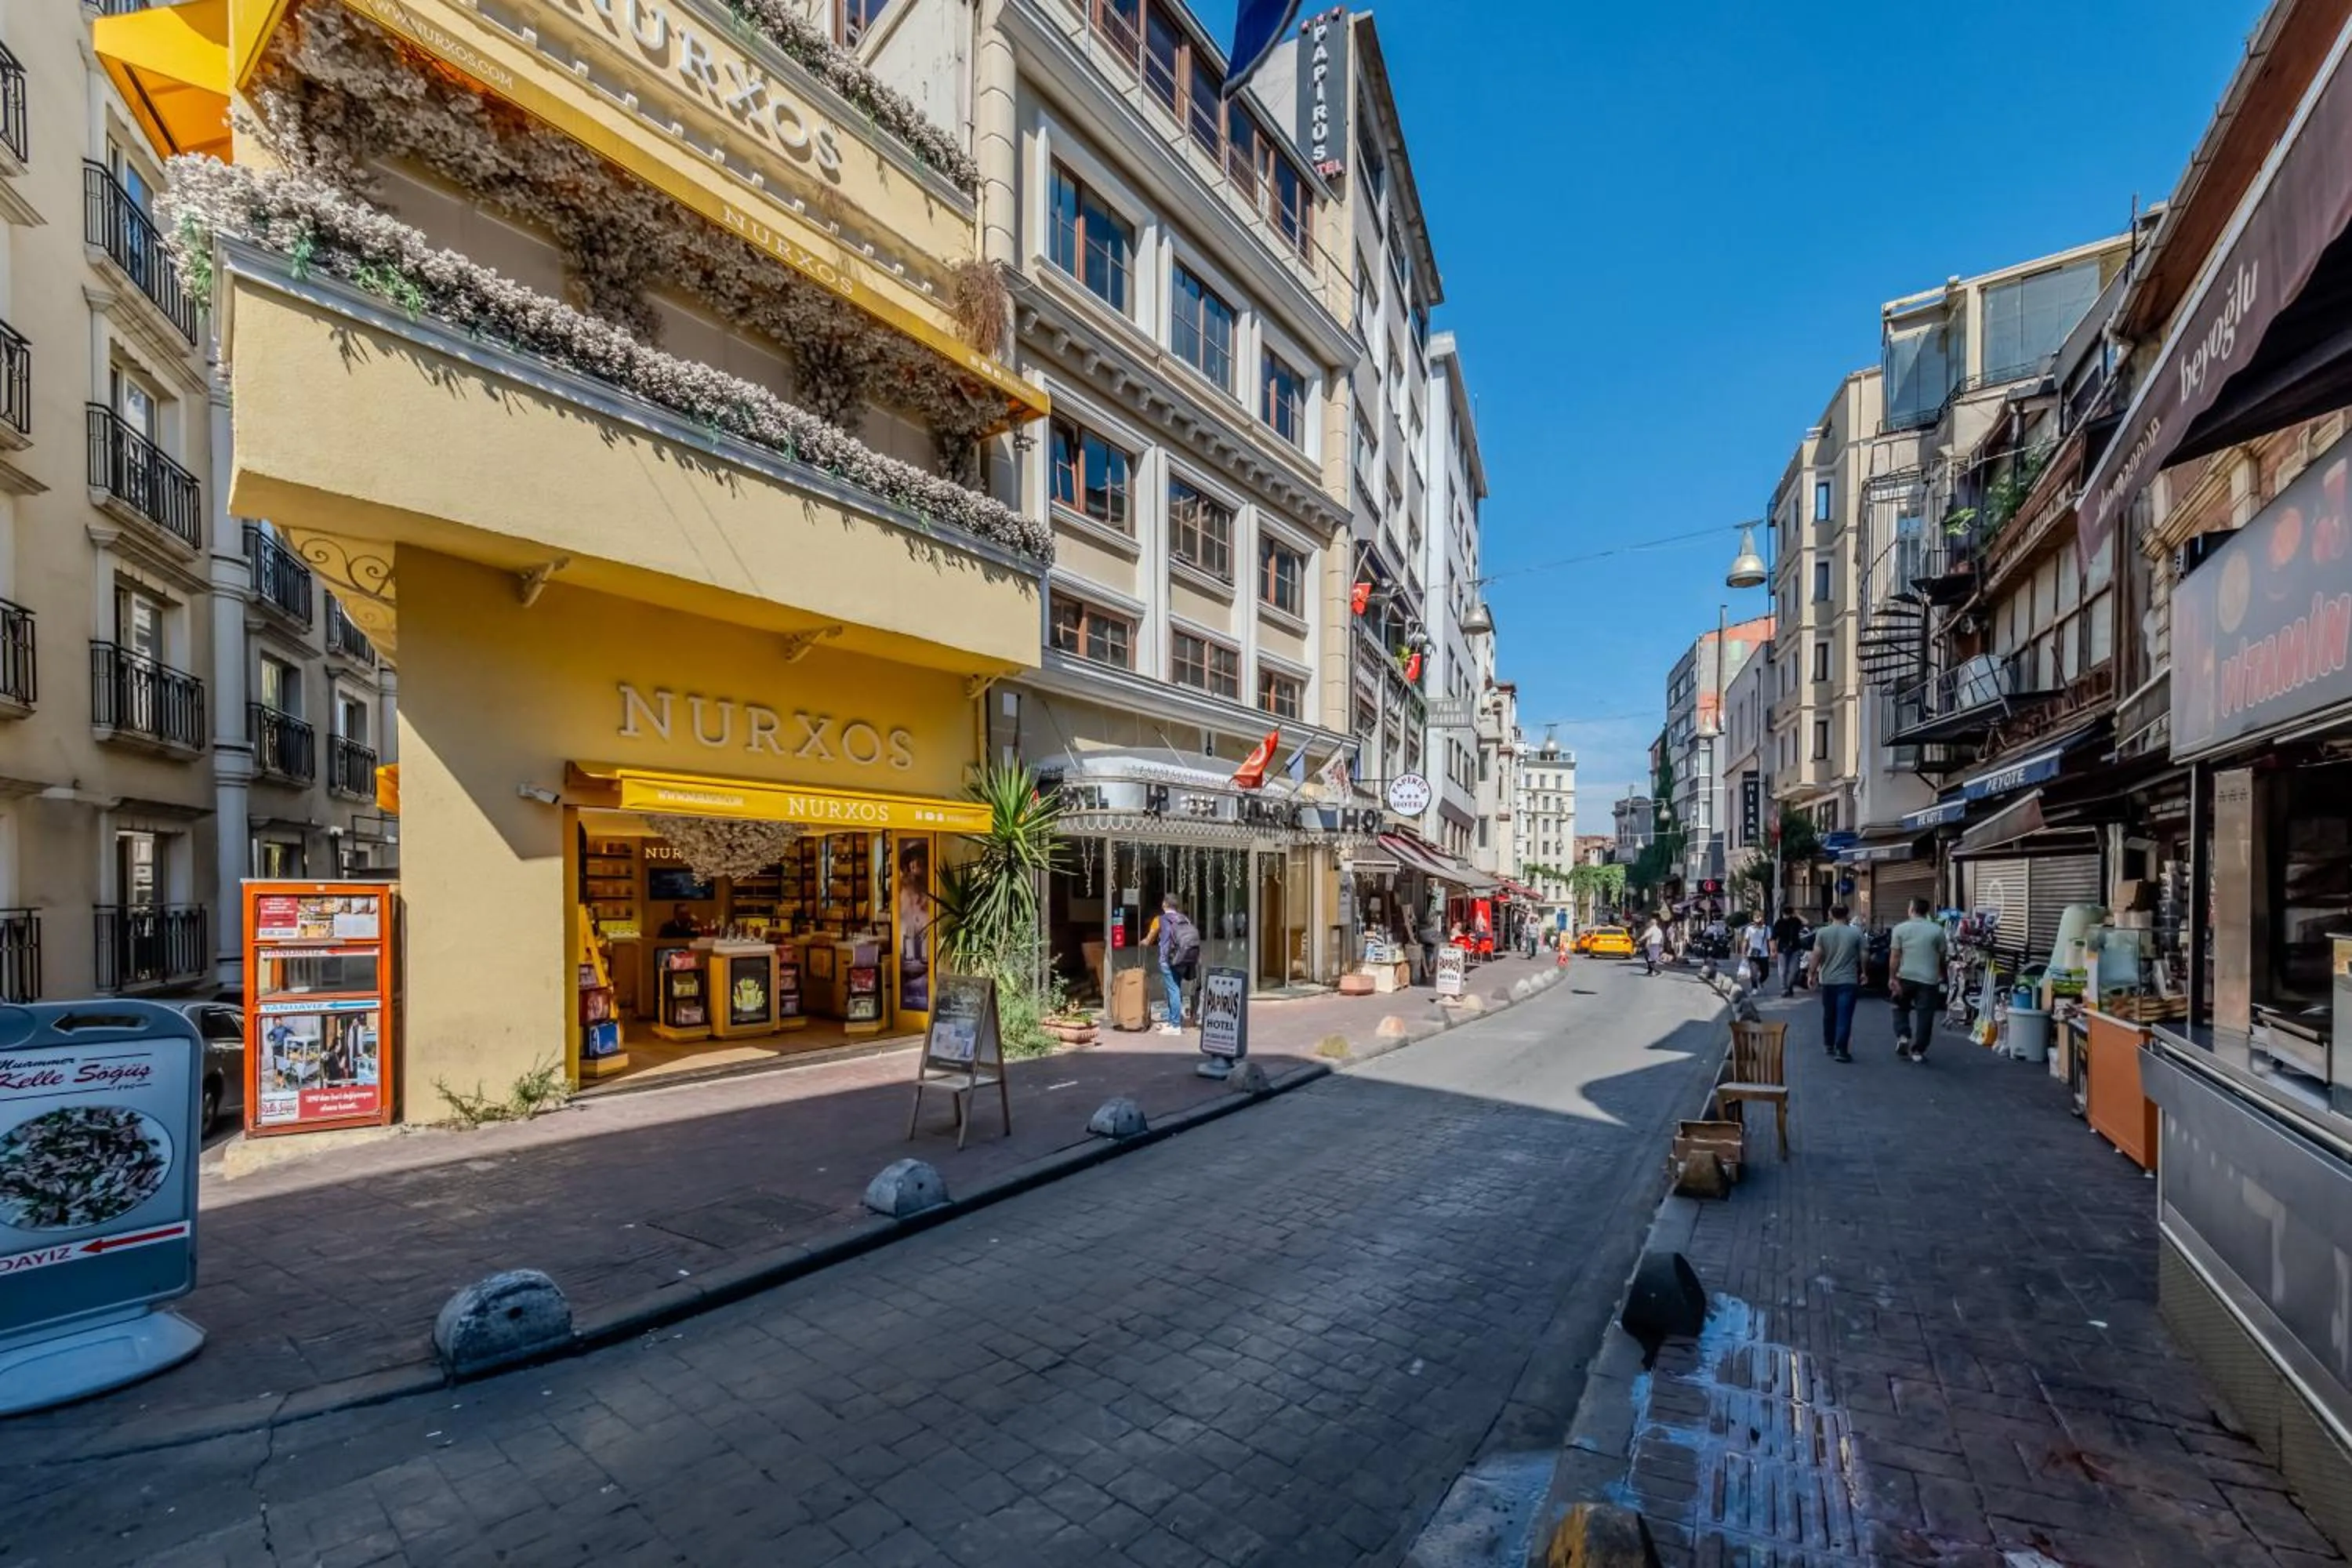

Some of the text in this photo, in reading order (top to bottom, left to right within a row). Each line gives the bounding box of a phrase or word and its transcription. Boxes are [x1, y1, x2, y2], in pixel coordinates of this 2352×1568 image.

[593, 0, 842, 170] URXOS
[1315, 160, 1344, 176] TEL
[723, 205, 855, 296] NURXOS
[2180, 260, 2259, 405] beyoğlu
[617, 684, 914, 771] NURXOS
[1986, 768, 2026, 791] PEYOTE
[787, 797, 890, 822] NURXOS
[644, 847, 684, 860] NUR
[1207, 1020, 1235, 1031] HOTEL
[0, 1063, 151, 1090] Kelle Söğüş
